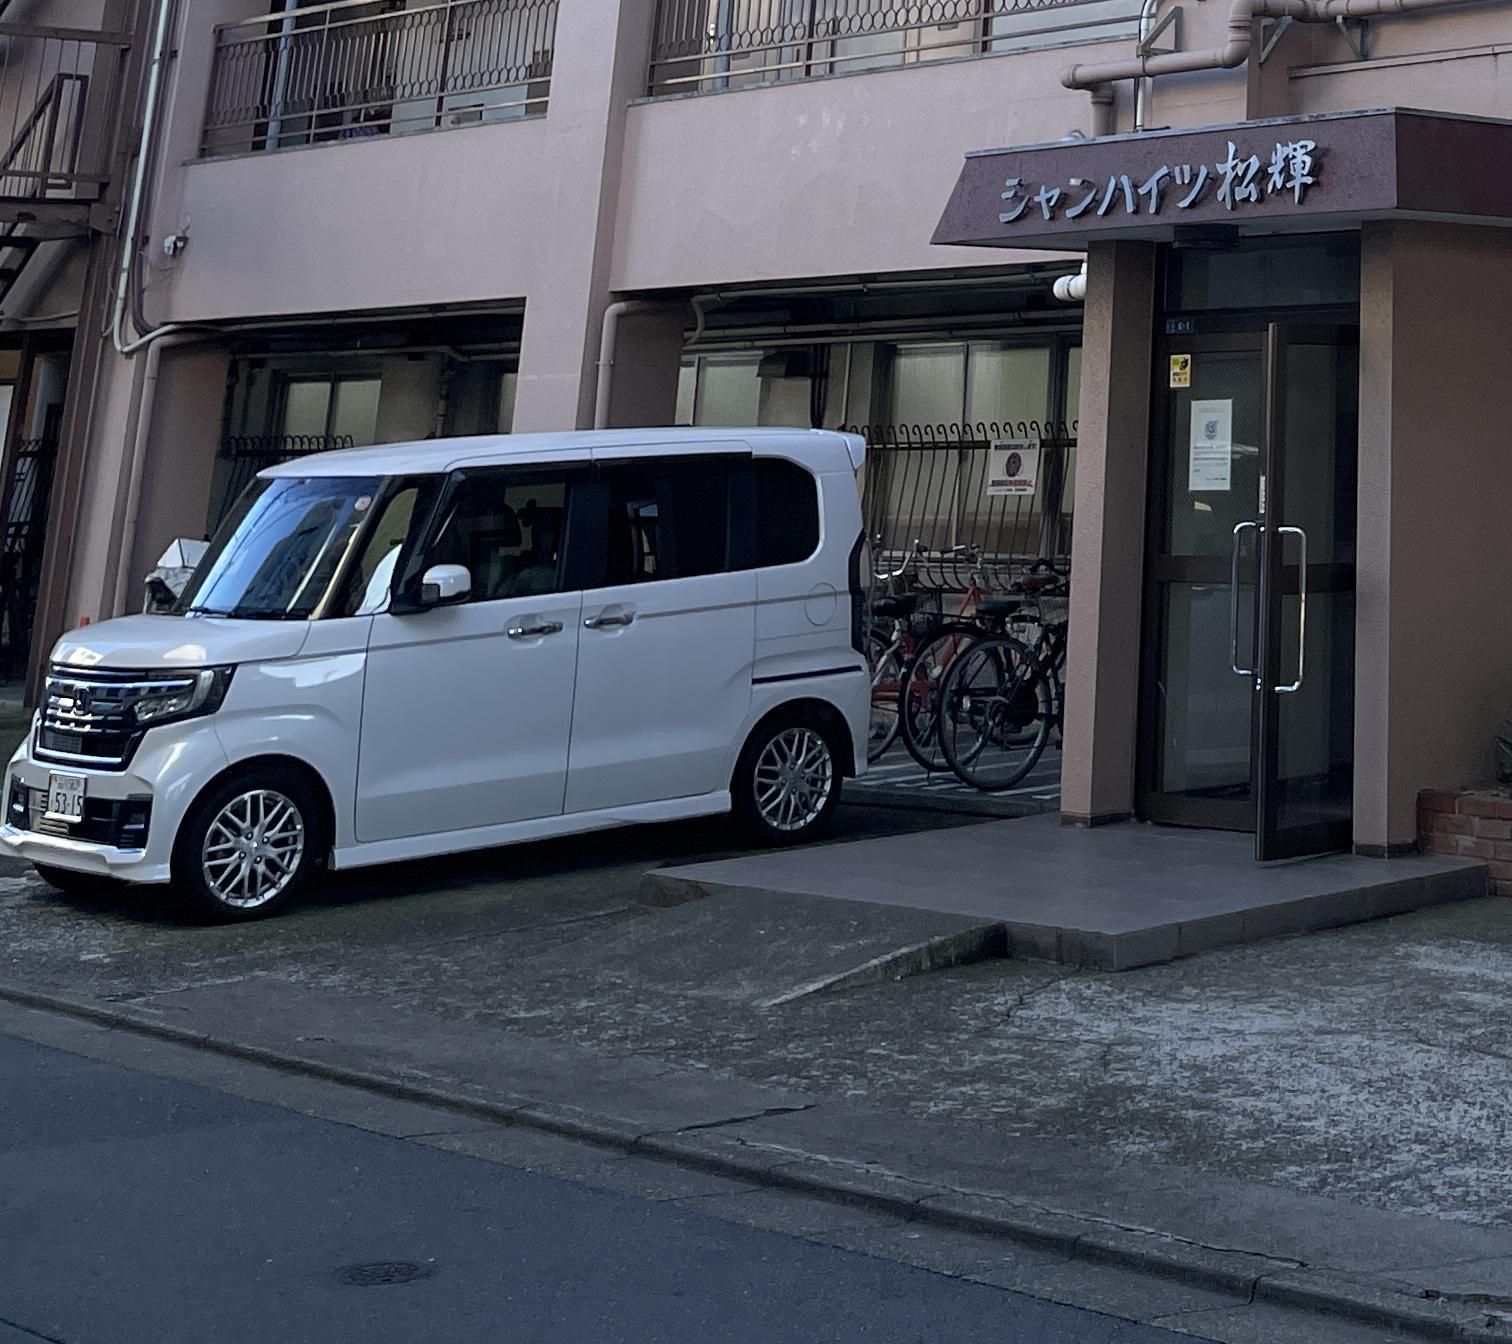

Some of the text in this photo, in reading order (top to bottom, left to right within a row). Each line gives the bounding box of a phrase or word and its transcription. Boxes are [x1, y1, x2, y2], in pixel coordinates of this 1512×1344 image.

[998, 140, 1317, 224] シャンハイツ松輝
